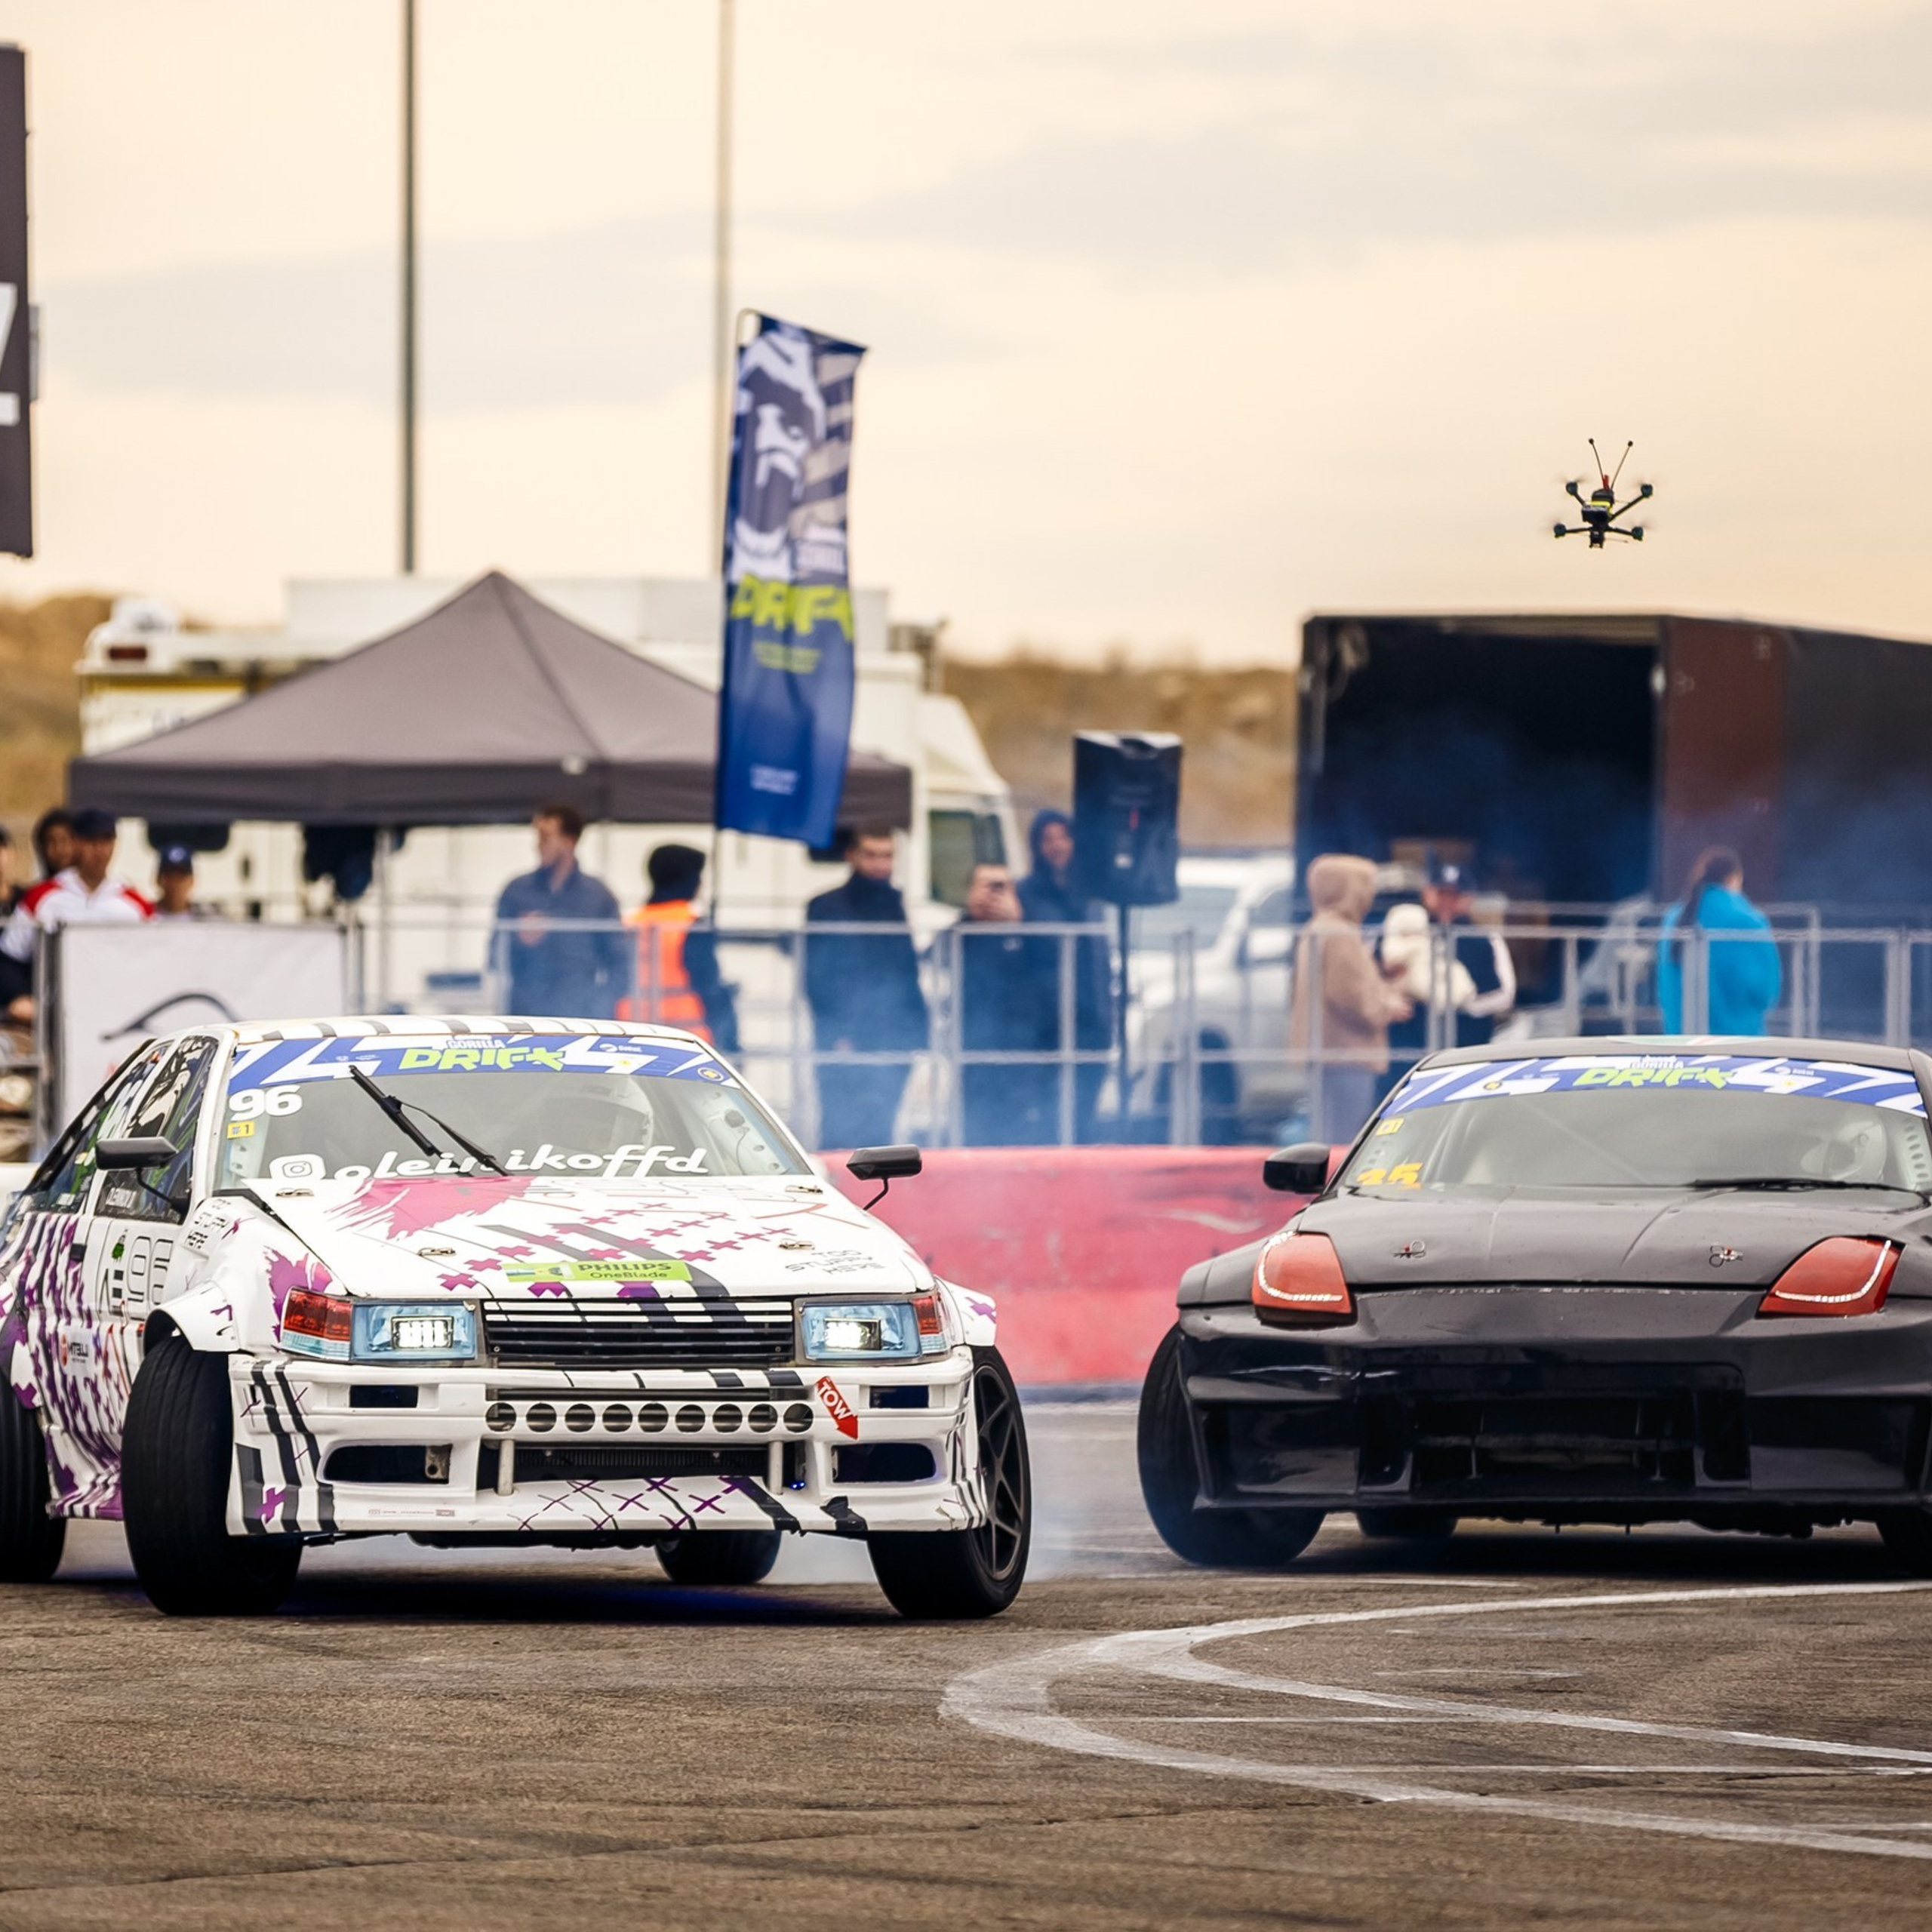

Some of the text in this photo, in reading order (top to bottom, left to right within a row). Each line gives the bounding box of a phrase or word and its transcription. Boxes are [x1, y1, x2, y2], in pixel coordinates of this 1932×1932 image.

[447, 1038, 506, 1049] GORILLA
[229, 1084, 302, 1121] 96
[578, 1263, 672, 1272] PHILIPS
[817, 1381, 854, 1420] TOW
